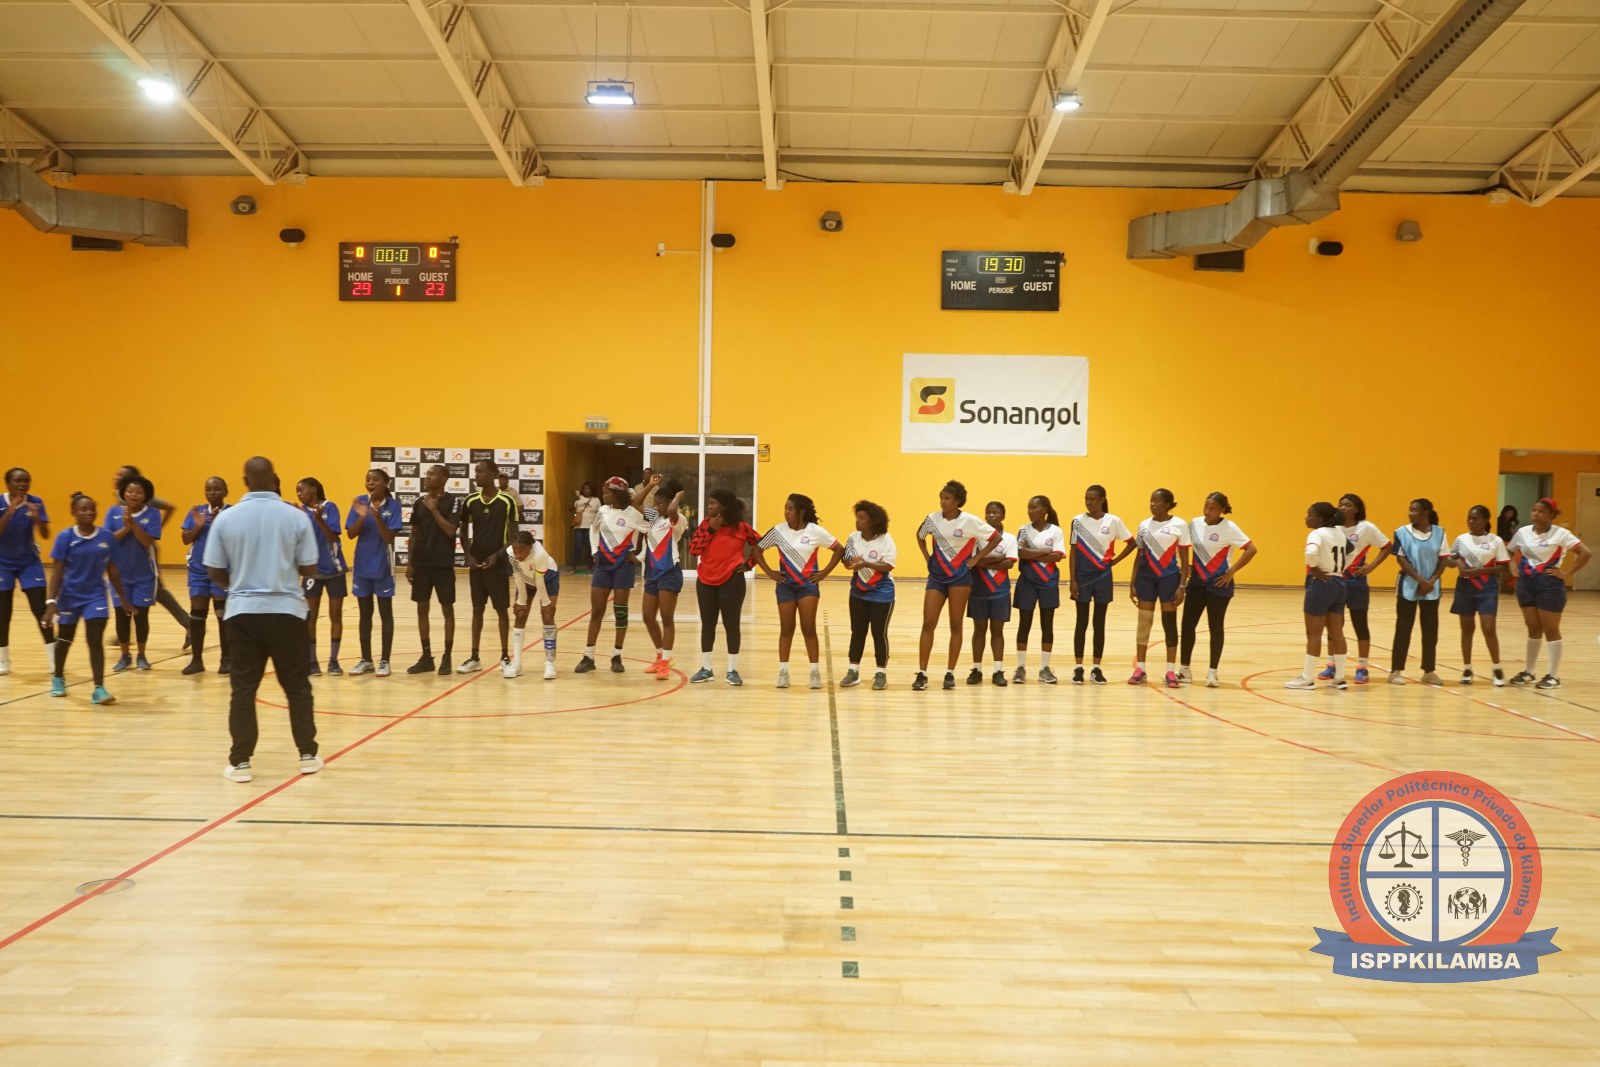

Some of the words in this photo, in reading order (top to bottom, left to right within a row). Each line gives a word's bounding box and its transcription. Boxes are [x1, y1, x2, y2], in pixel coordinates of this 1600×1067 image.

[356, 247, 364, 258] 0
[429, 247, 437, 258] 0
[984, 257, 999, 272] 19
[1003, 257, 1023, 272] 30
[347, 272, 374, 282] HOME
[419, 272, 449, 282] GUEST
[352, 282, 372, 296] 29
[396, 285, 401, 296] 1
[425, 282, 445, 296] 23
[950, 280, 977, 291] HOME
[988, 286, 1014, 294] PERIODE
[1022, 281, 1053, 291] GUEST
[959, 399, 1081, 432] Sonangol
[1331, 545, 1346, 574] 11
[306, 578, 315, 591] 9
